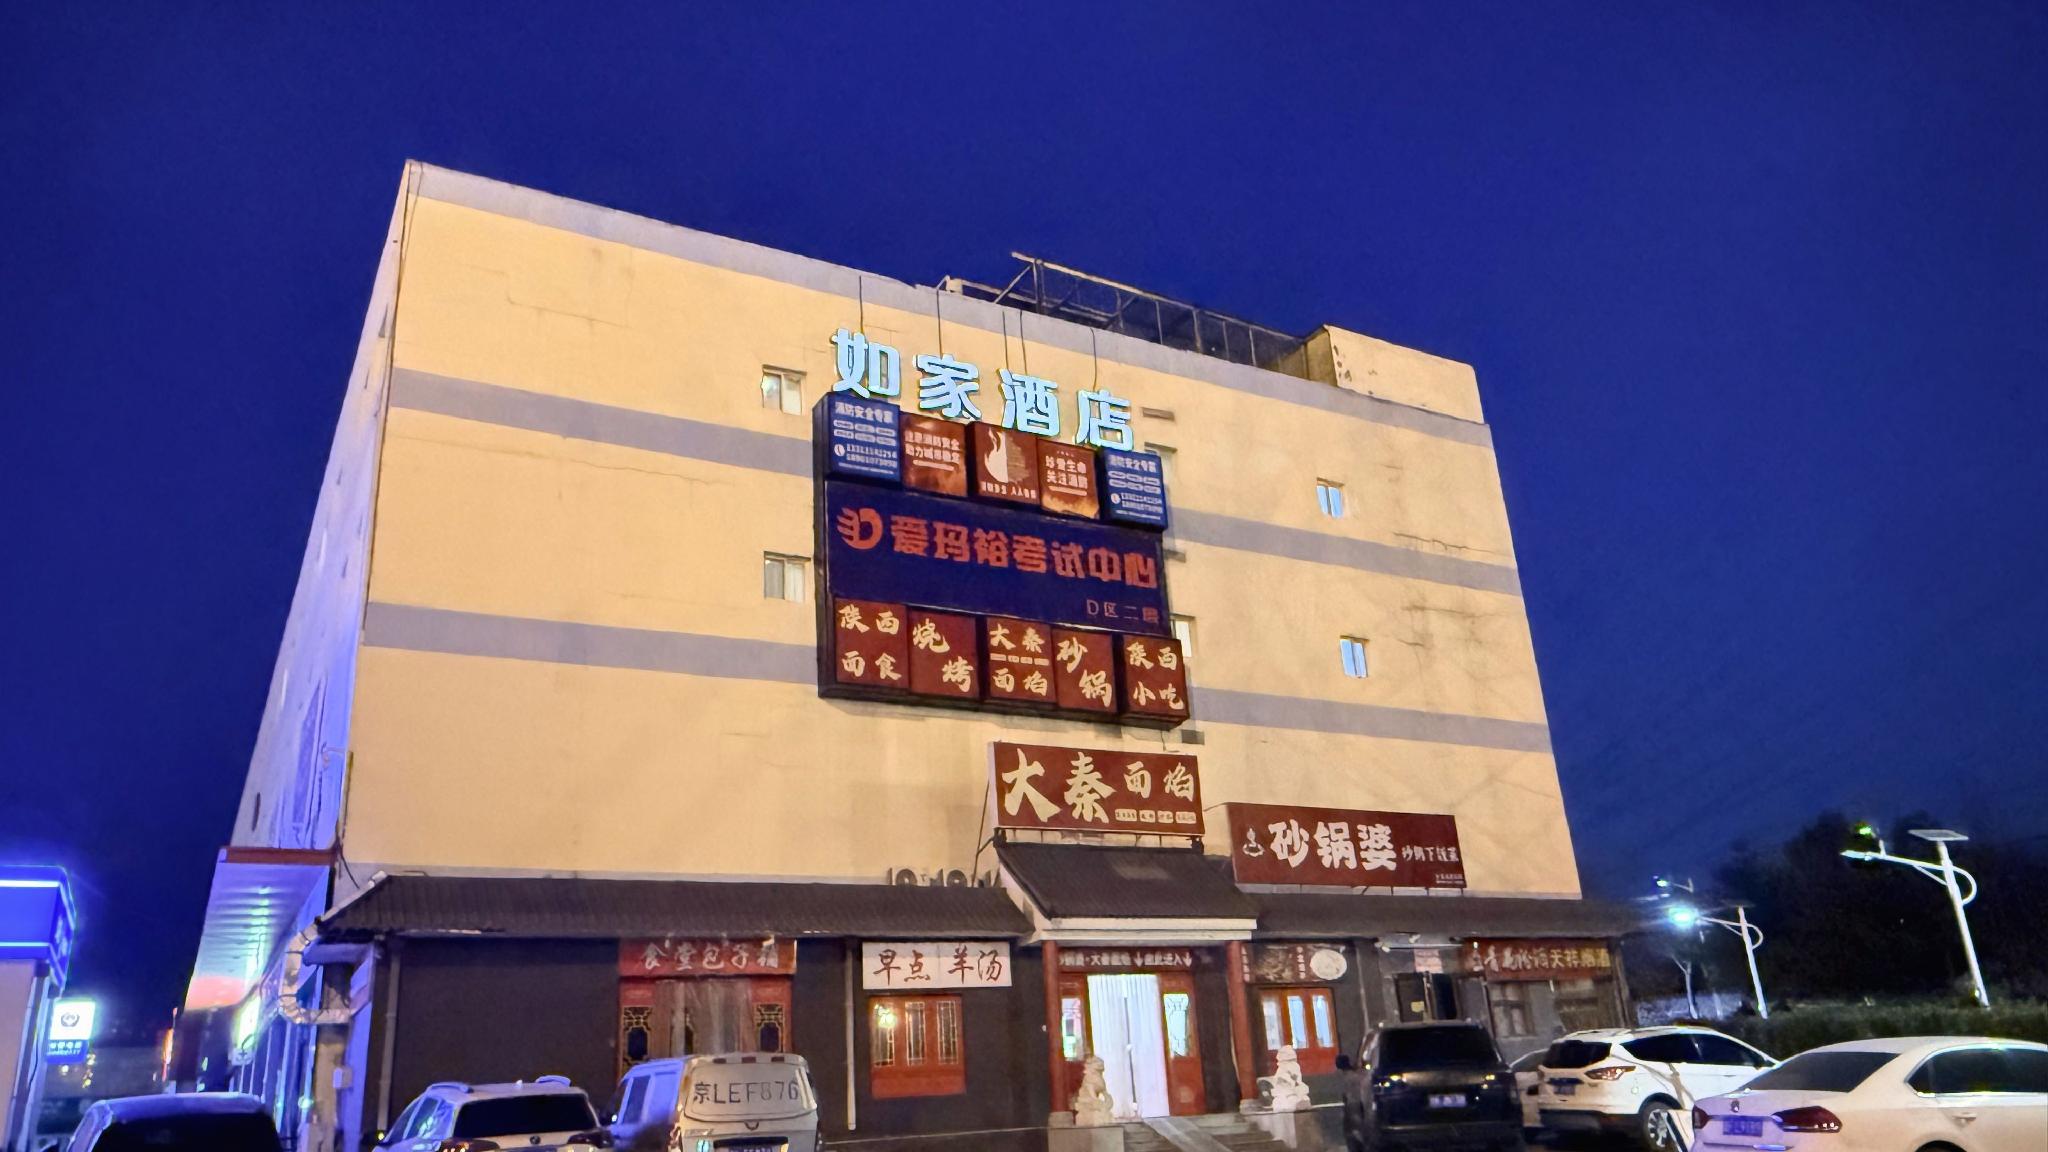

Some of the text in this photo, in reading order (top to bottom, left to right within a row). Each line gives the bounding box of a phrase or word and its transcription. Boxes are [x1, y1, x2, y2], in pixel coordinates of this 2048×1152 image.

[829, 327, 1134, 451] 如家酒店
[890, 514, 1158, 589] 爱玛裕考试中心
[838, 603, 900, 635] 陕西
[841, 650, 902, 681] 面食
[912, 618, 974, 693] 烧烤
[1056, 637, 1113, 708] 砂锅
[1132, 681, 1185, 710] 小吃
[1267, 818, 1397, 871] 砂锅婆
[873, 945, 1002, 985] 早点 羊汤
